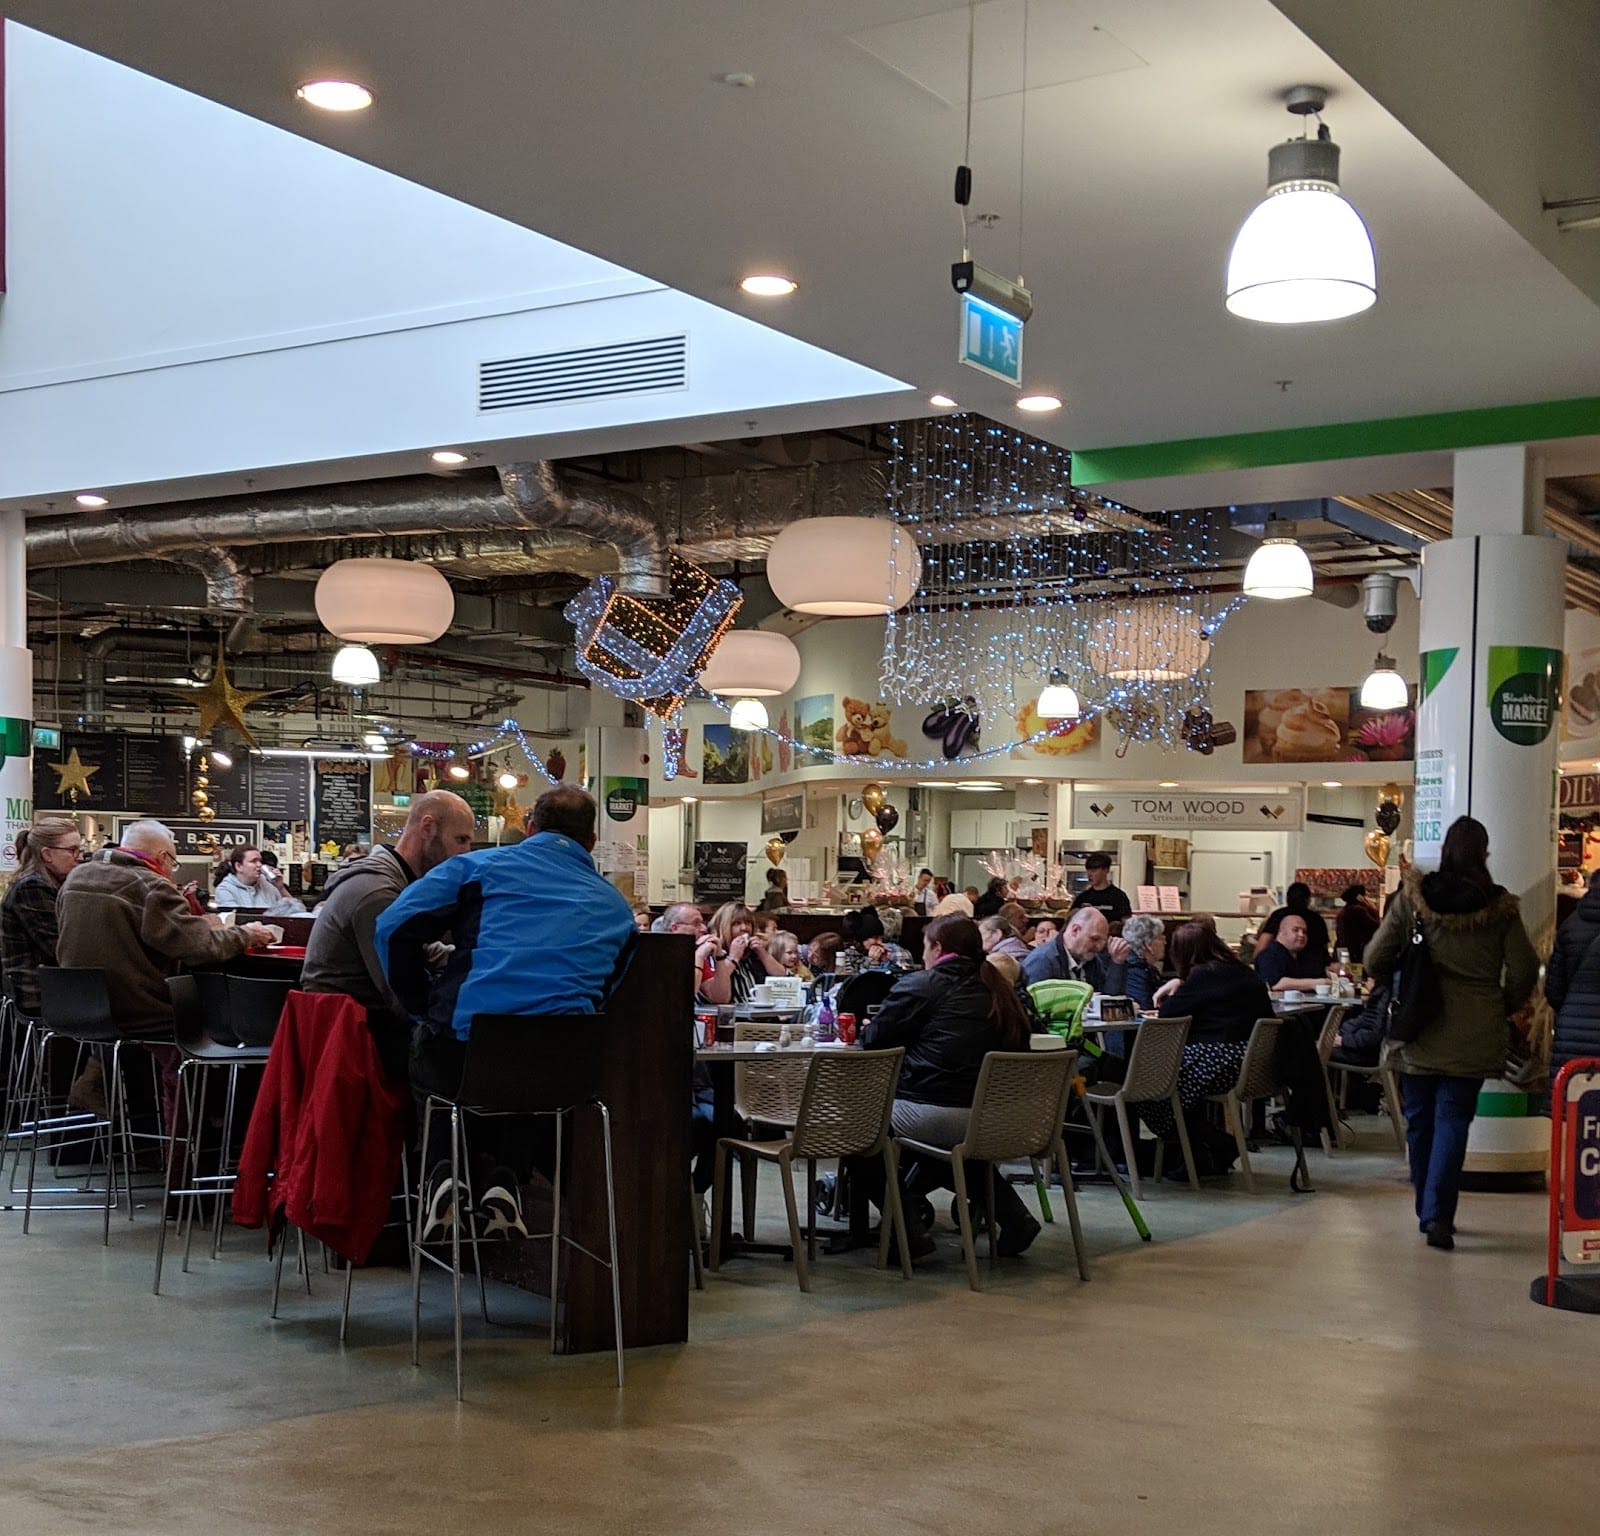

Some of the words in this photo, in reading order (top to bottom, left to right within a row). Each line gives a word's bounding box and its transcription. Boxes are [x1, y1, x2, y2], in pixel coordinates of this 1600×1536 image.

[1502, 703, 1548, 721] MARKET
[1131, 800, 1172, 813] TOM
[1183, 801, 1244, 814] WOOD
[187, 832, 246, 846] BEAD
